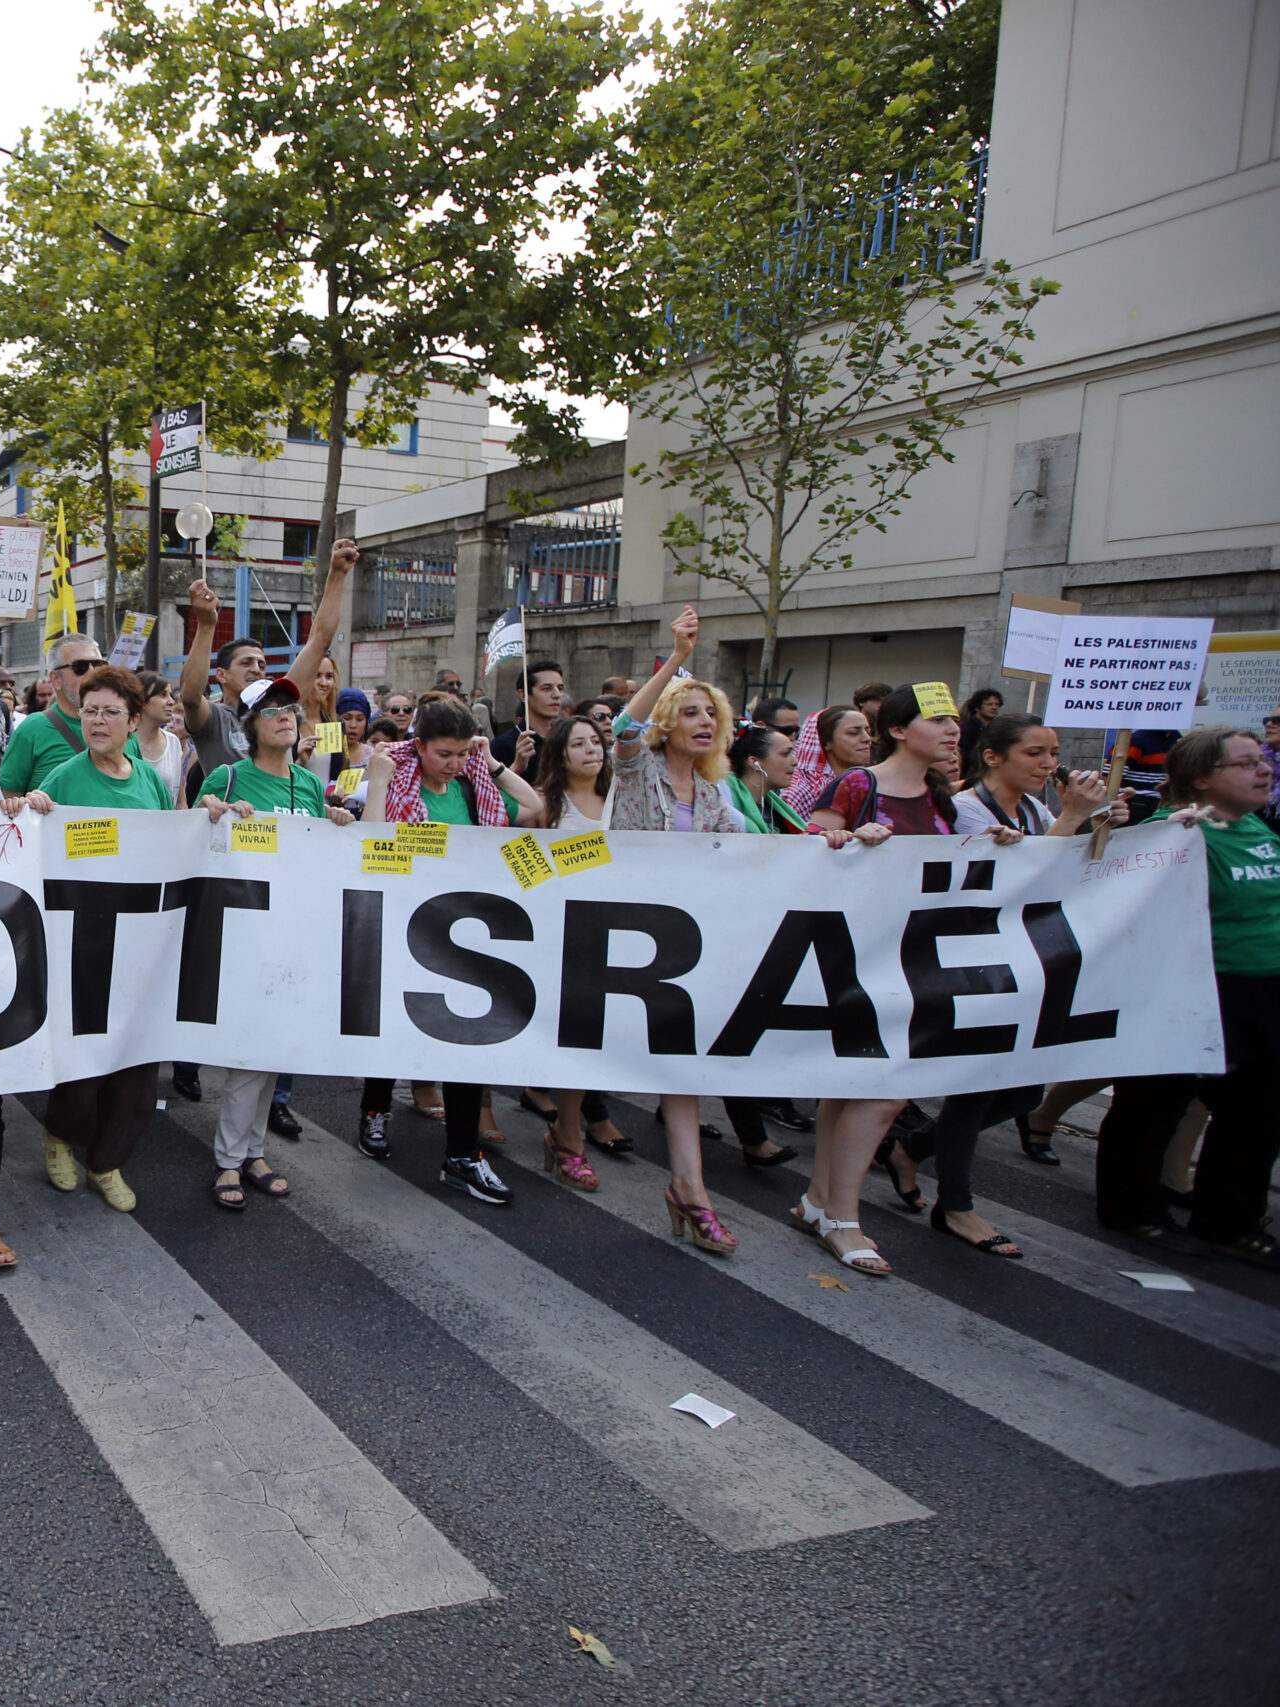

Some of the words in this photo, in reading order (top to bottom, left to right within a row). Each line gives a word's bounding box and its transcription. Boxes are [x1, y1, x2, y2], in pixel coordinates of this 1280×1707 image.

[160, 416, 166, 430] A
[167, 409, 188, 428] BAS
[166, 434, 176, 449] LE
[156, 449, 198, 475] SIONISME
[8, 588, 27, 603] LDJ
[1074, 637, 1102, 648] LES
[1107, 638, 1198, 650] PALESTINIENS
[1064, 658, 1084, 669] NE
[1089, 659, 1165, 671] PARTIRONT
[1169, 660, 1191, 671] PAS
[1220, 660, 1231, 668] LE
[1233, 660, 1273, 668] SERVICE
[1061, 678, 1085, 689] ILS
[1089, 679, 1129, 690] SONT
[1132, 680, 1165, 691] CHEZ
[1168, 681, 1192, 692] EUX
[1064, 699, 1104, 710] DANS
[1107, 700, 1143, 711] LEUR
[1146, 701, 1183, 712] DROIT
[1220, 704, 1240, 712] SUR
[1240, 704, 1252, 712] LE
[1254, 704, 1275, 712] SITE
[67, 820, 112, 831] PALESTINE
[232, 823, 277, 833] PALESTINE
[409, 829, 447, 837] COLLABORATION
[551, 836, 605, 858] PALESTINE
[515, 845, 538, 877] ISRAEL
[523, 835, 552, 874] BOYCOTT
[501, 844, 515, 861] ETAT
[511, 860, 532, 888] RACISTE
[339, 858, 1119, 1058] ISRAËL
